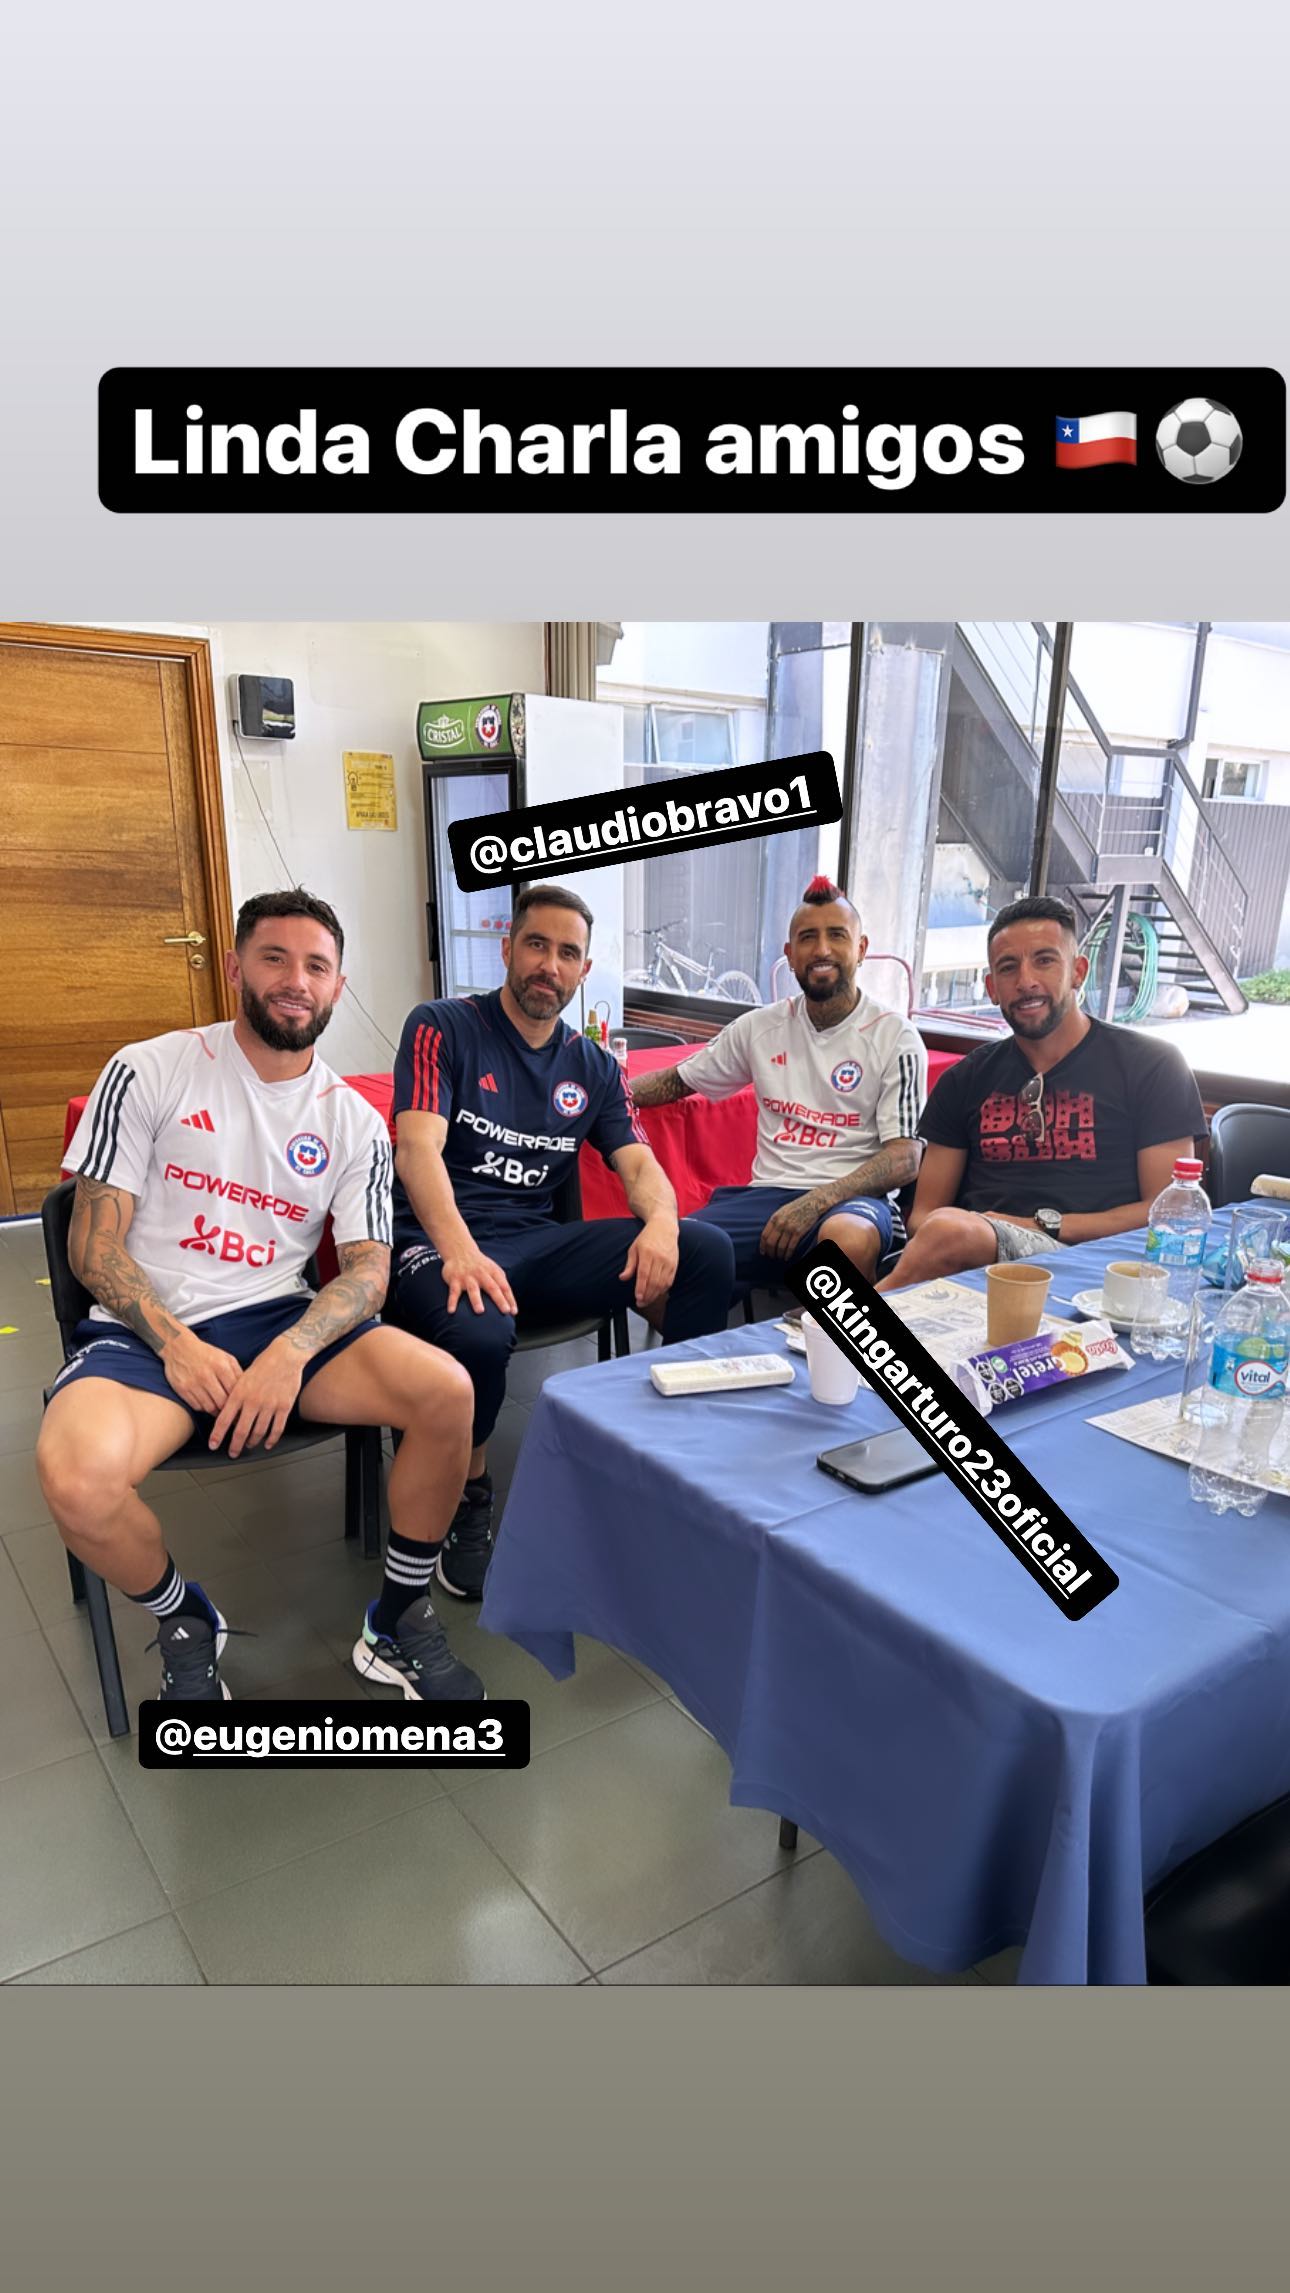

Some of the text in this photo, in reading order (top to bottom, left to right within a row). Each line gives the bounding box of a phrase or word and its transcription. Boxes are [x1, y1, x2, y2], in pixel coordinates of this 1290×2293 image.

[427, 726, 462, 744] CRISTAL
[762, 1097, 861, 1128] POWERADE
[455, 1108, 577, 1153] POWERADE
[503, 1158, 549, 1187] Bci
[219, 1229, 277, 1268] Bci
[1012, 1355, 1066, 1385] Gretel
[1240, 1369, 1271, 1384] vital
